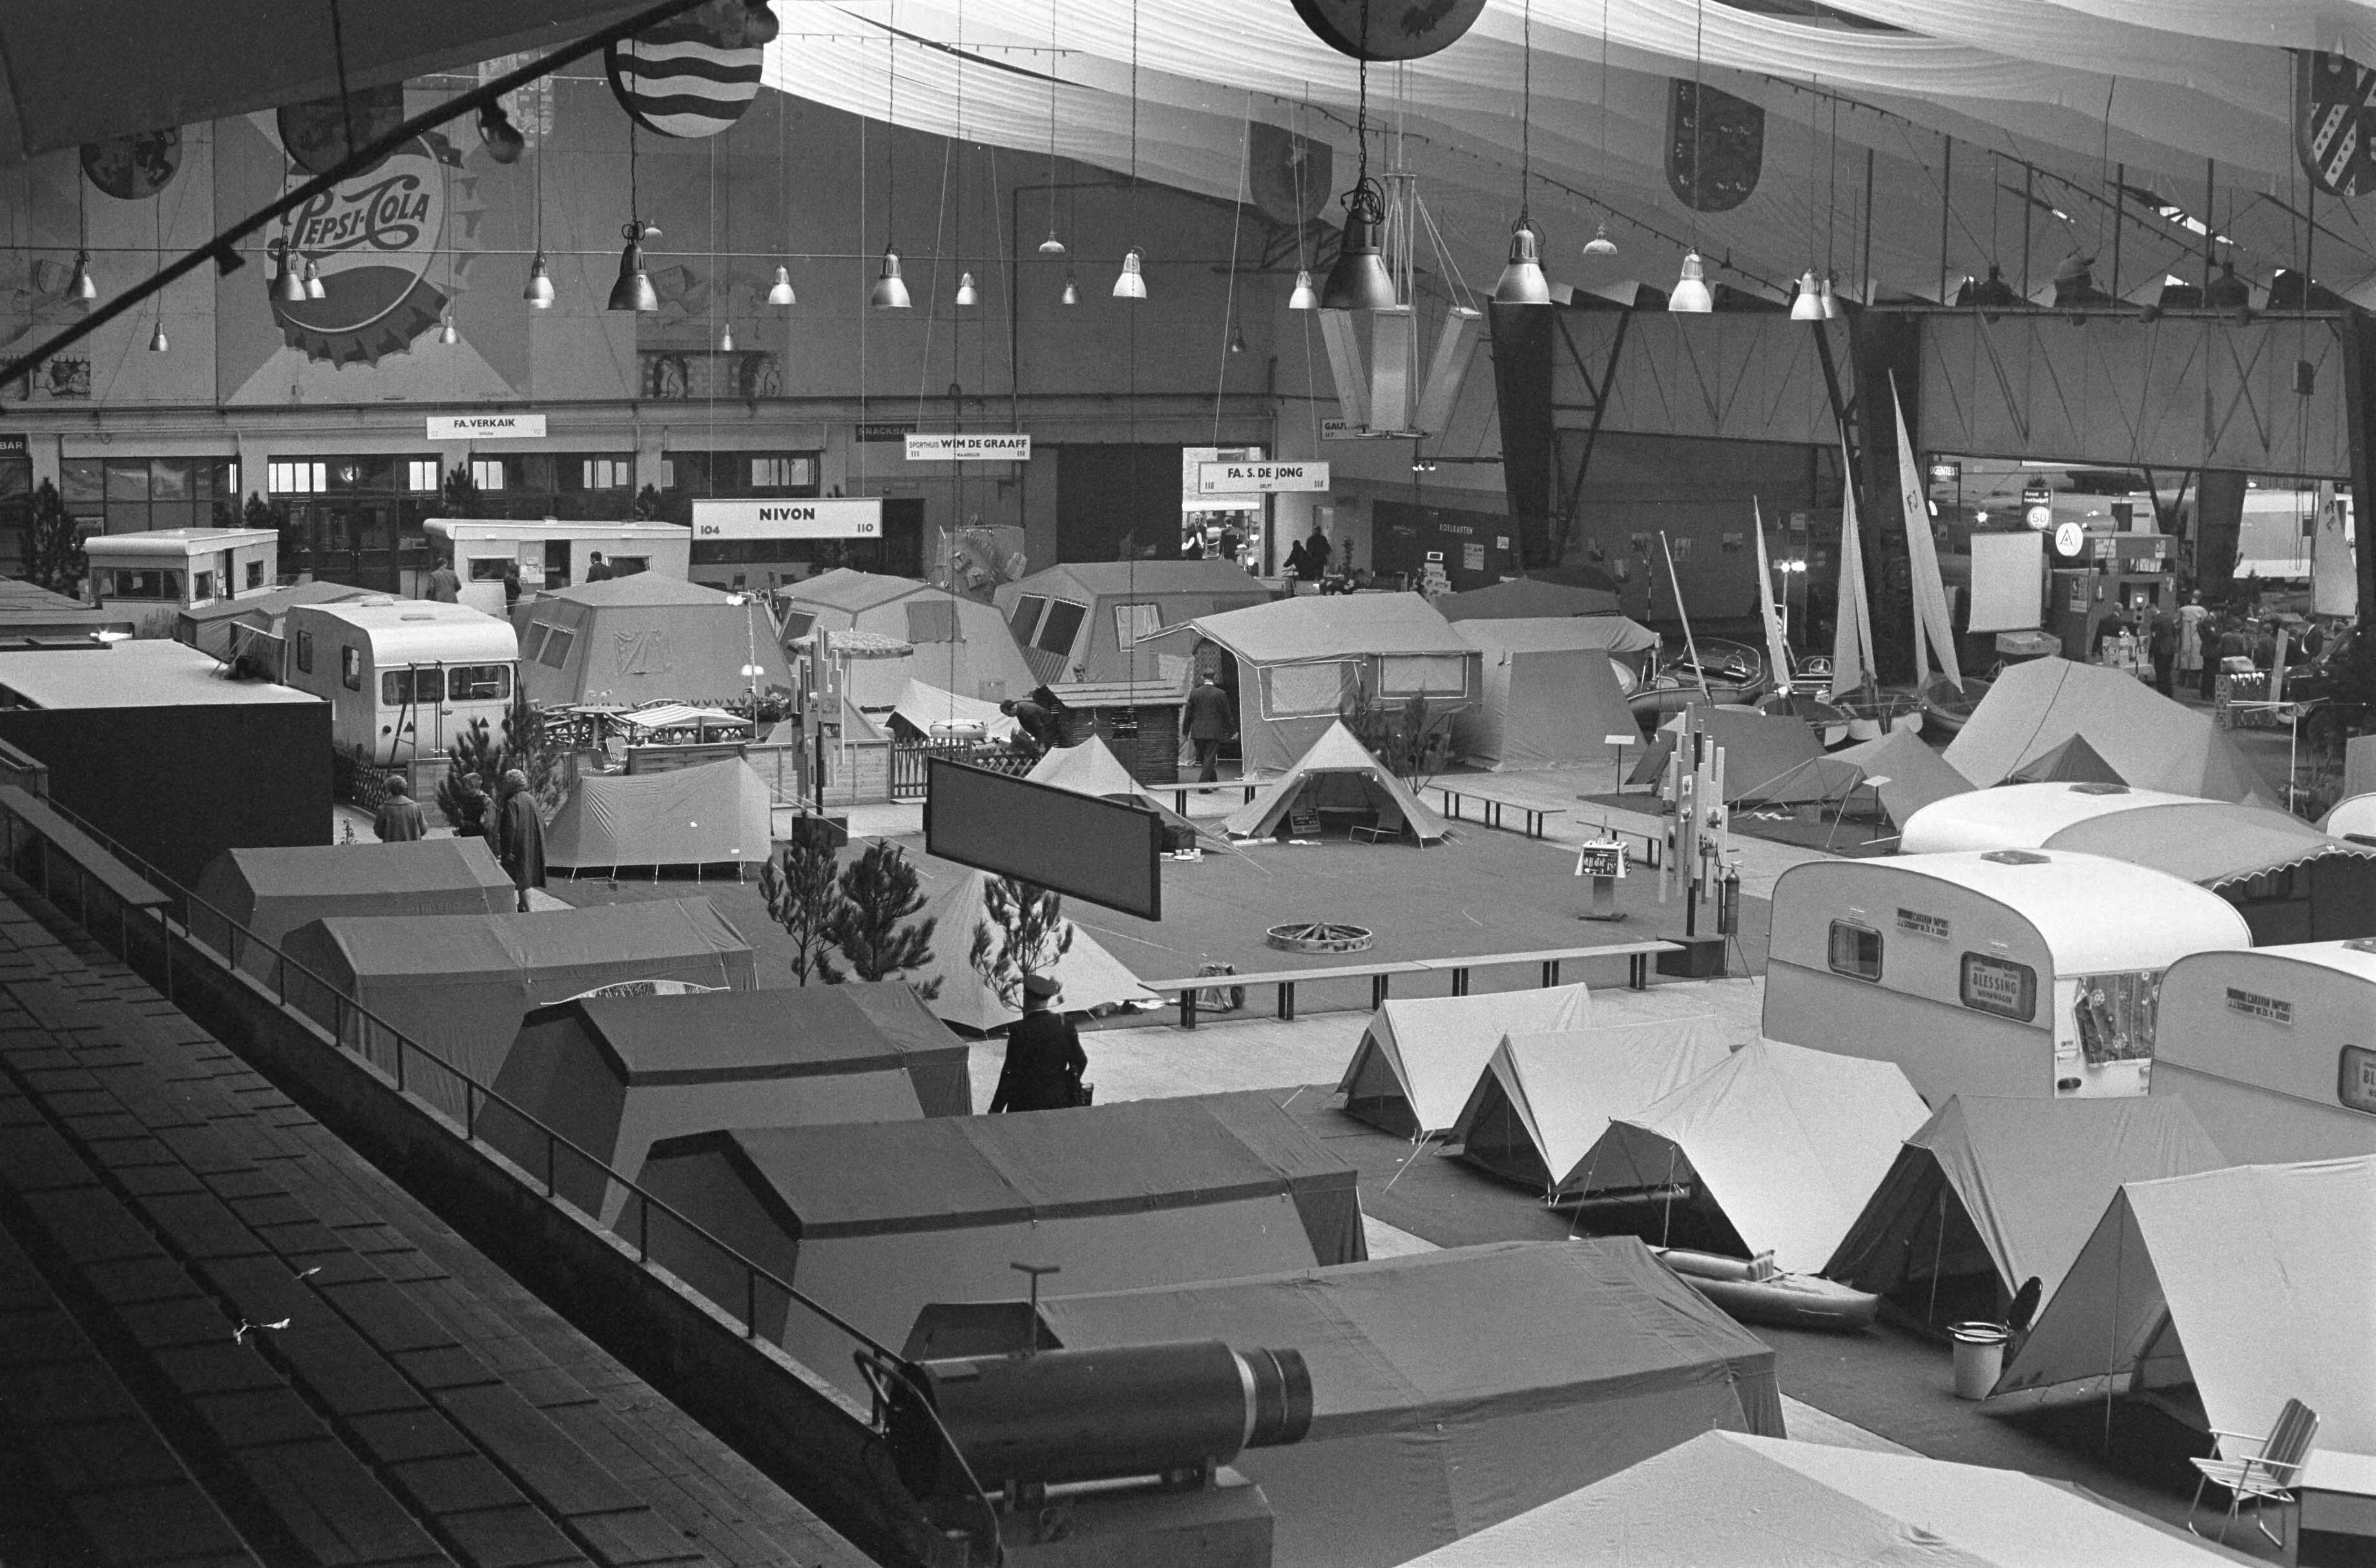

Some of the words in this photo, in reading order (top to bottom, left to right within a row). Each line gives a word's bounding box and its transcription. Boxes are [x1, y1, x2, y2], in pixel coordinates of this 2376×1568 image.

[267, 174, 430, 261] PEPSI-COLA
[941, 439, 965, 448] WIM
[968, 439, 981, 448] DE
[984, 439, 1027, 448] GRAAFF
[1227, 468, 1244, 478] FA.
[1247, 468, 1255, 477] S.
[1258, 468, 1271, 477] DE
[1275, 468, 1303, 479] JONG
[759, 508, 815, 521] NIVON
[2032, 513, 2047, 522] 50
[700, 526, 720, 535] 104
[857, 524, 873, 533] 110
[1440, 522, 1474, 535] KOELKASTEN
[1973, 973, 2017, 995] BLESSING
